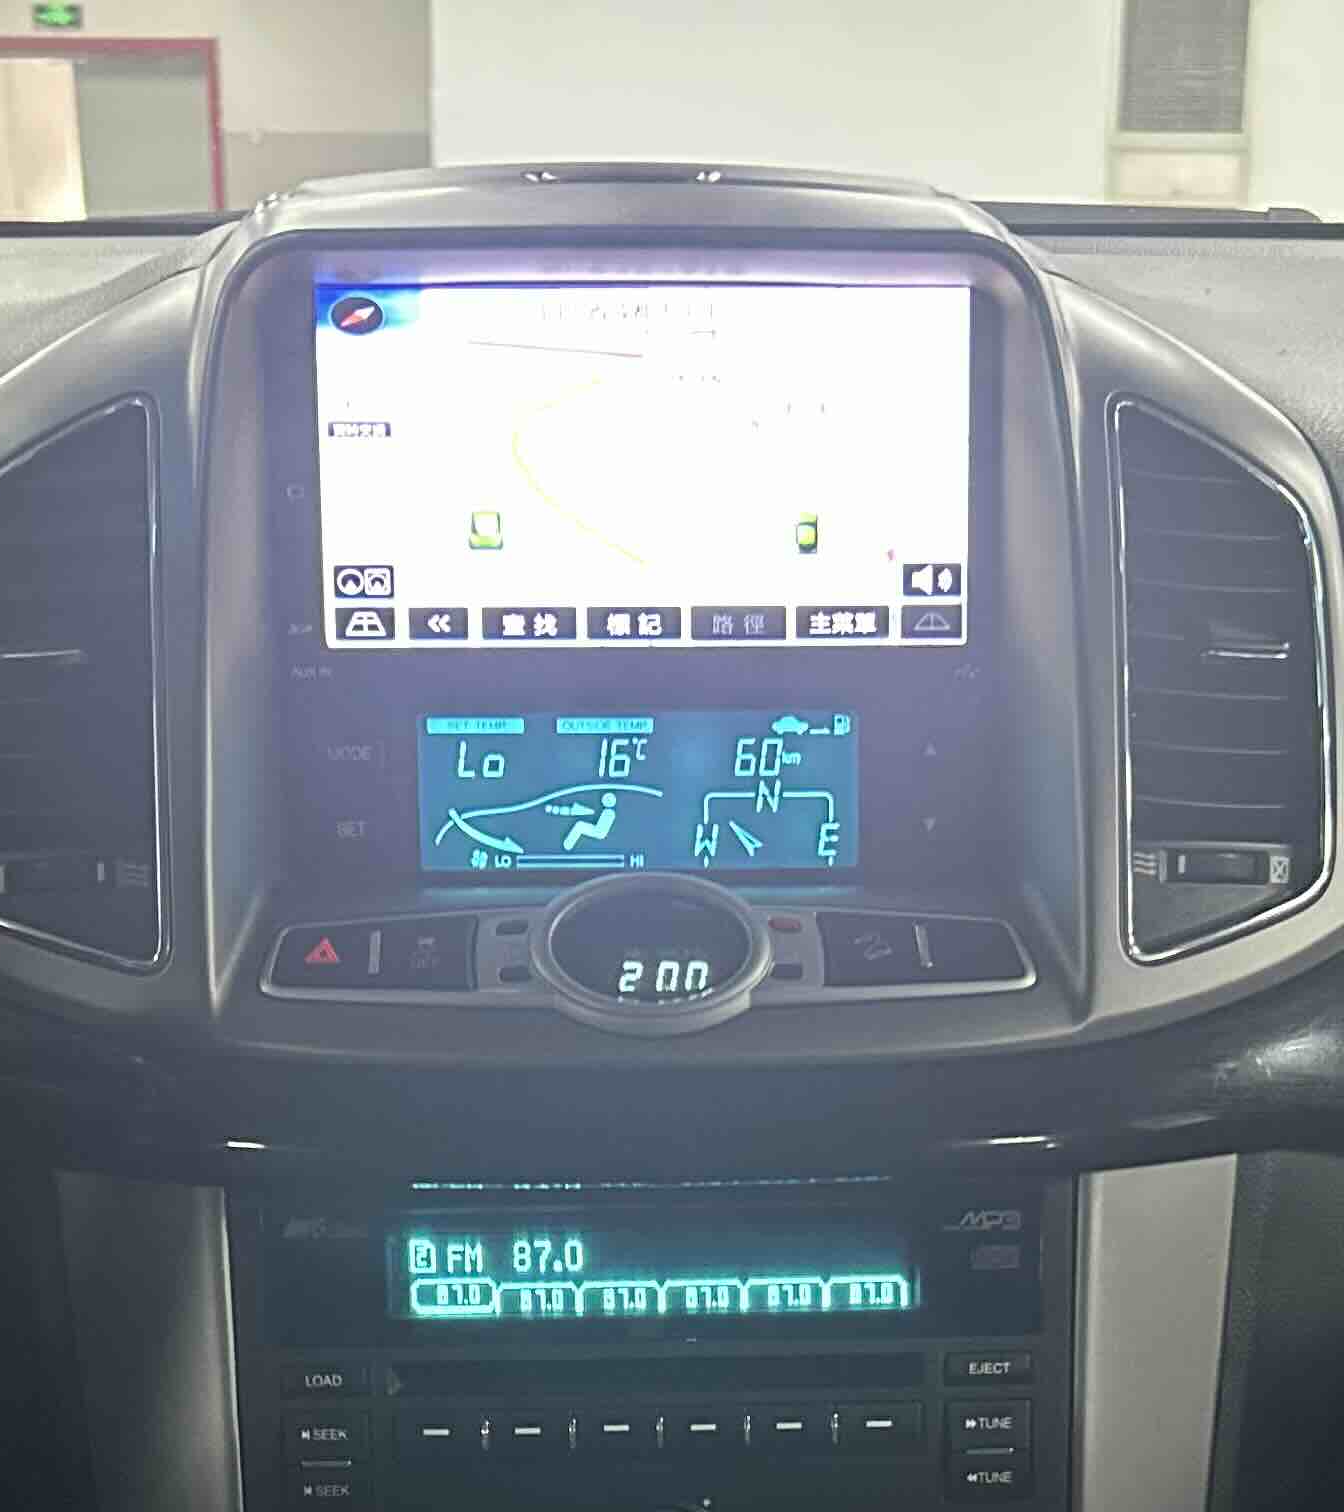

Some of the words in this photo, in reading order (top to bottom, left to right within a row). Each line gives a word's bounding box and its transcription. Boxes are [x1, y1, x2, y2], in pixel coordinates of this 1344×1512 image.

[809, 610, 877, 635] 主菜單
[756, 780, 781, 813] N
[694, 823, 719, 857] W
[818, 822, 840, 857] E
[448, 1241, 483, 1274] FM
[512, 1238, 584, 1274] 87.0
[968, 1361, 1011, 1375] EJECT
[305, 1374, 342, 1387] LOAD
[979, 1417, 1012, 1430] TUNE
[313, 1428, 348, 1441] SEEK
[979, 1471, 1012, 1484] TUNE
[315, 1484, 350, 1497] SEEK
